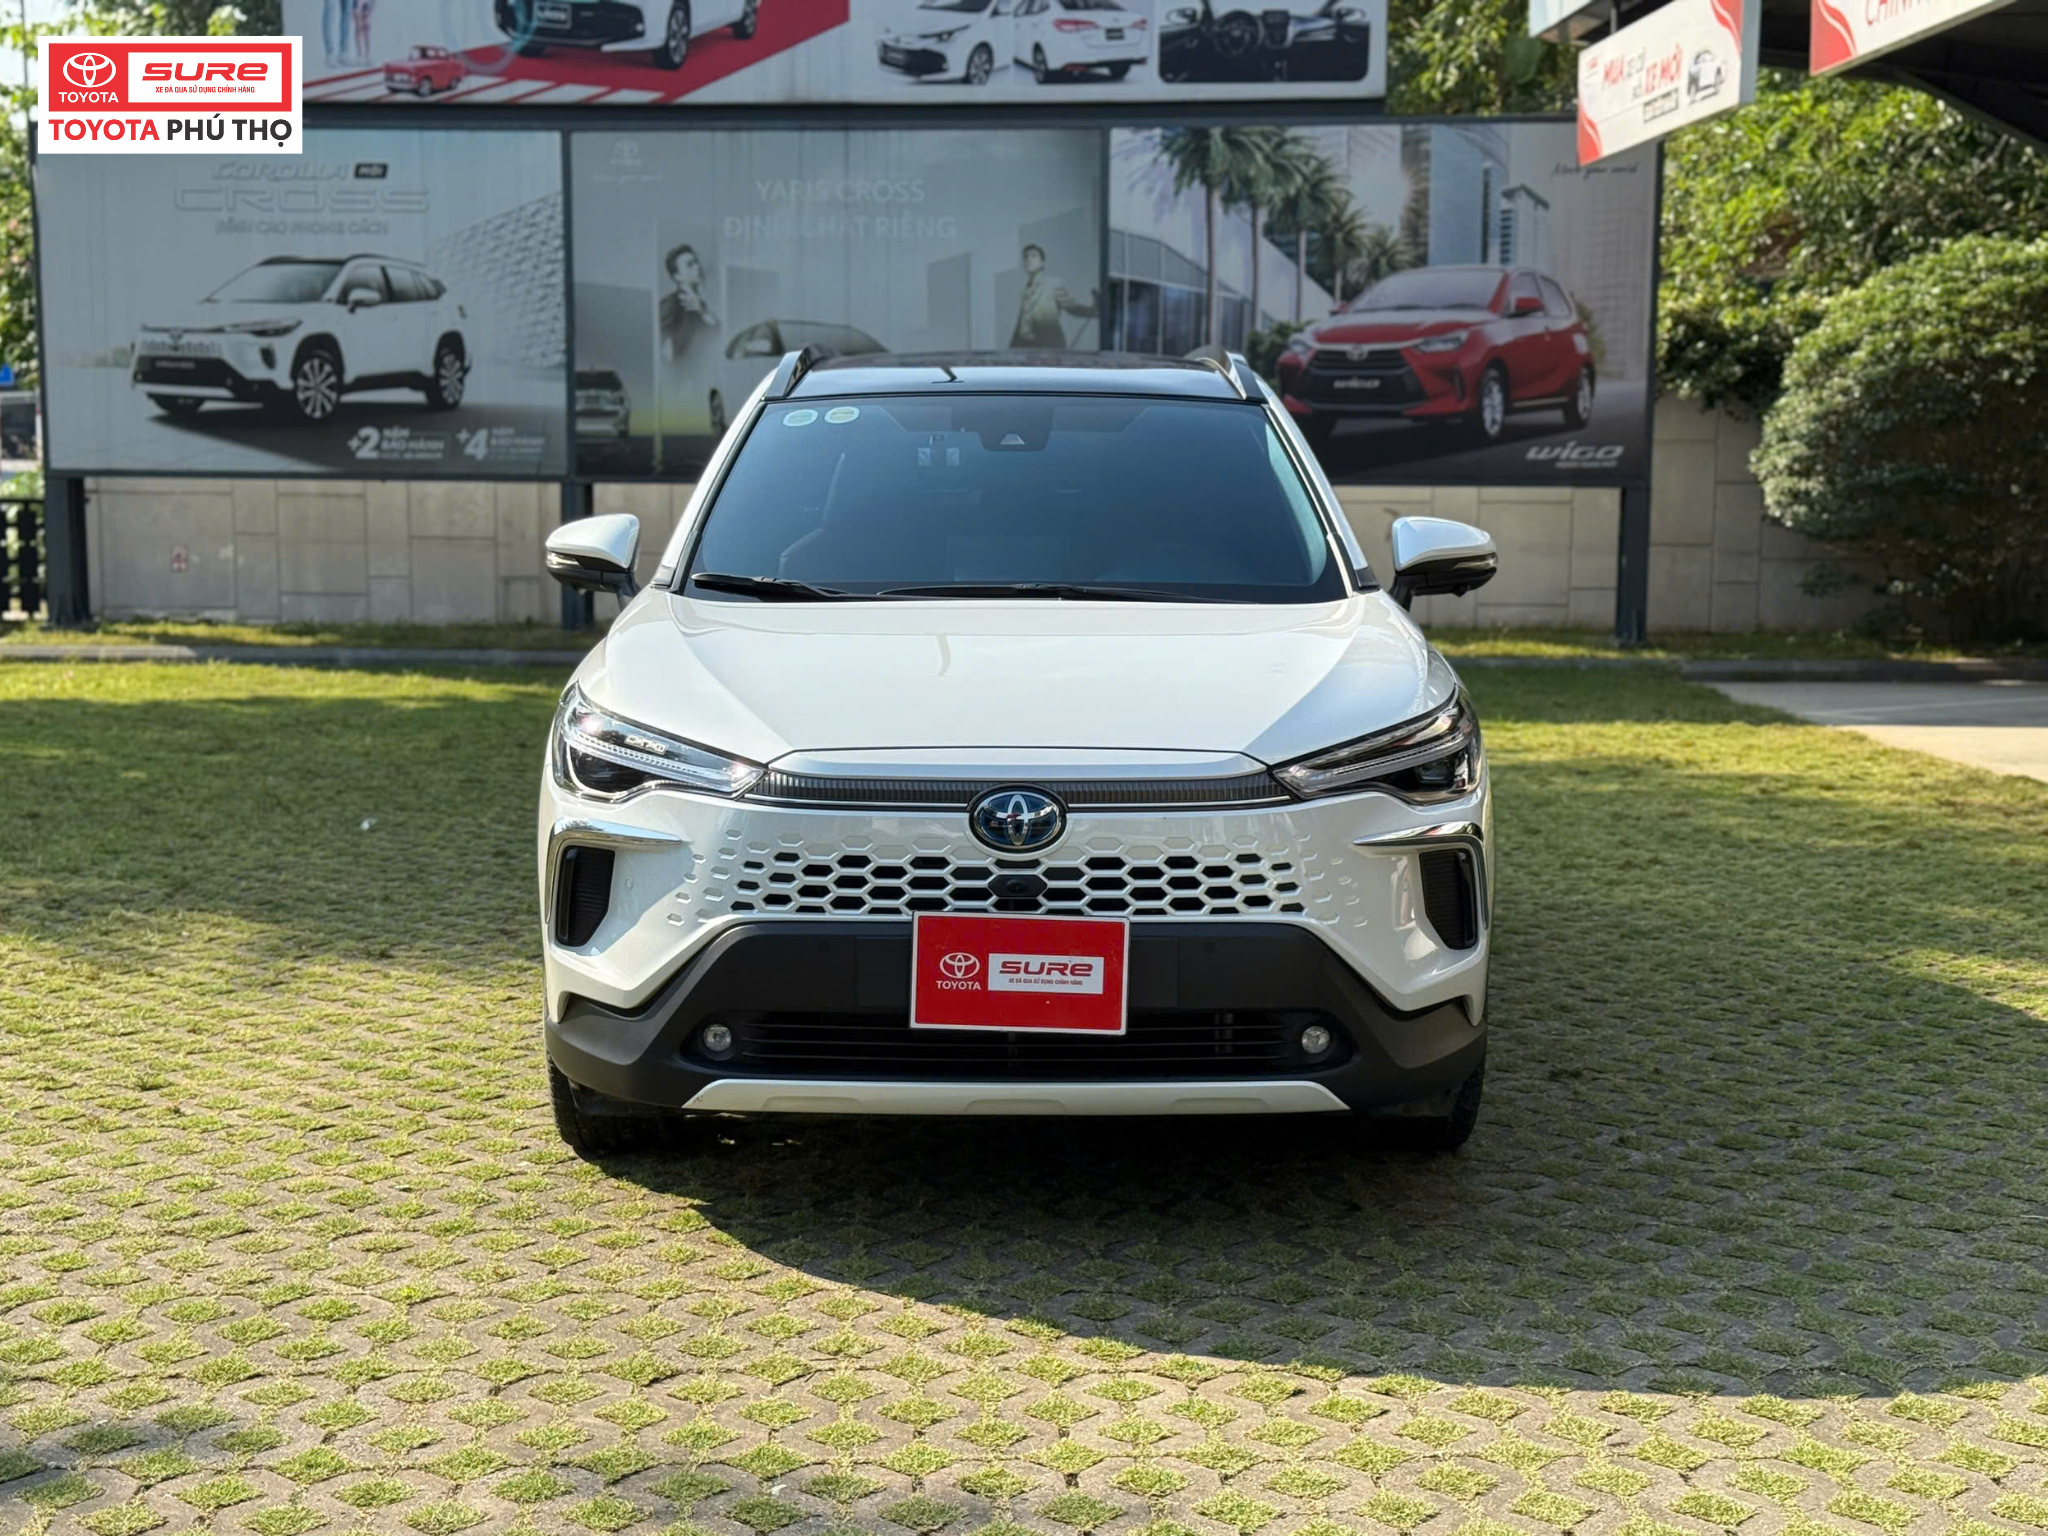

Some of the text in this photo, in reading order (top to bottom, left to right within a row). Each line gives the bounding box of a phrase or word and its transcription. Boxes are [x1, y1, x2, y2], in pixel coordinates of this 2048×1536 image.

[211, 161, 348, 182] COROLLA
[174, 187, 431, 214] CROSS
[755, 178, 926, 203] YARIS CROSS
[935, 980, 982, 991] TOYOTA
